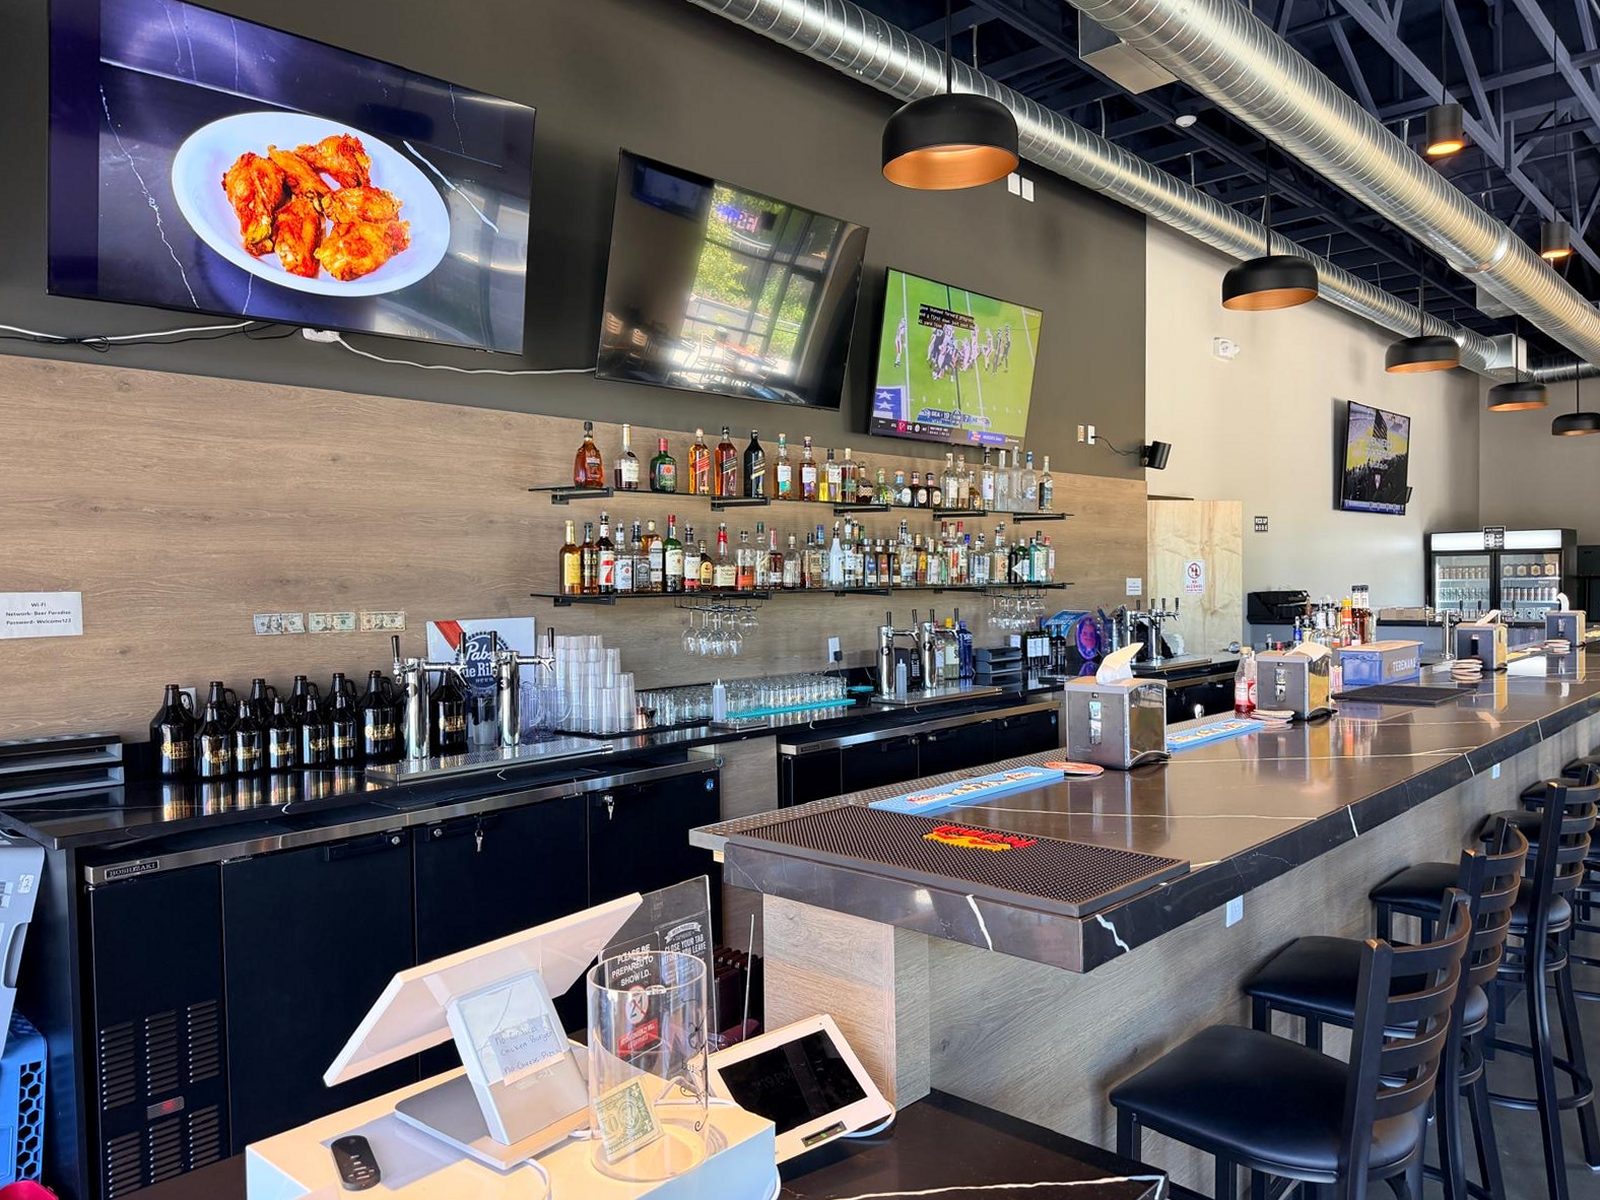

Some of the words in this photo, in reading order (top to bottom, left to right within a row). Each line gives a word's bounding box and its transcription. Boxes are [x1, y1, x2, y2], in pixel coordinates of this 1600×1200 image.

[600, 560, 614, 583] 7
[611, 959, 645, 978] PREPARED
[620, 971, 640, 987] SHOW
